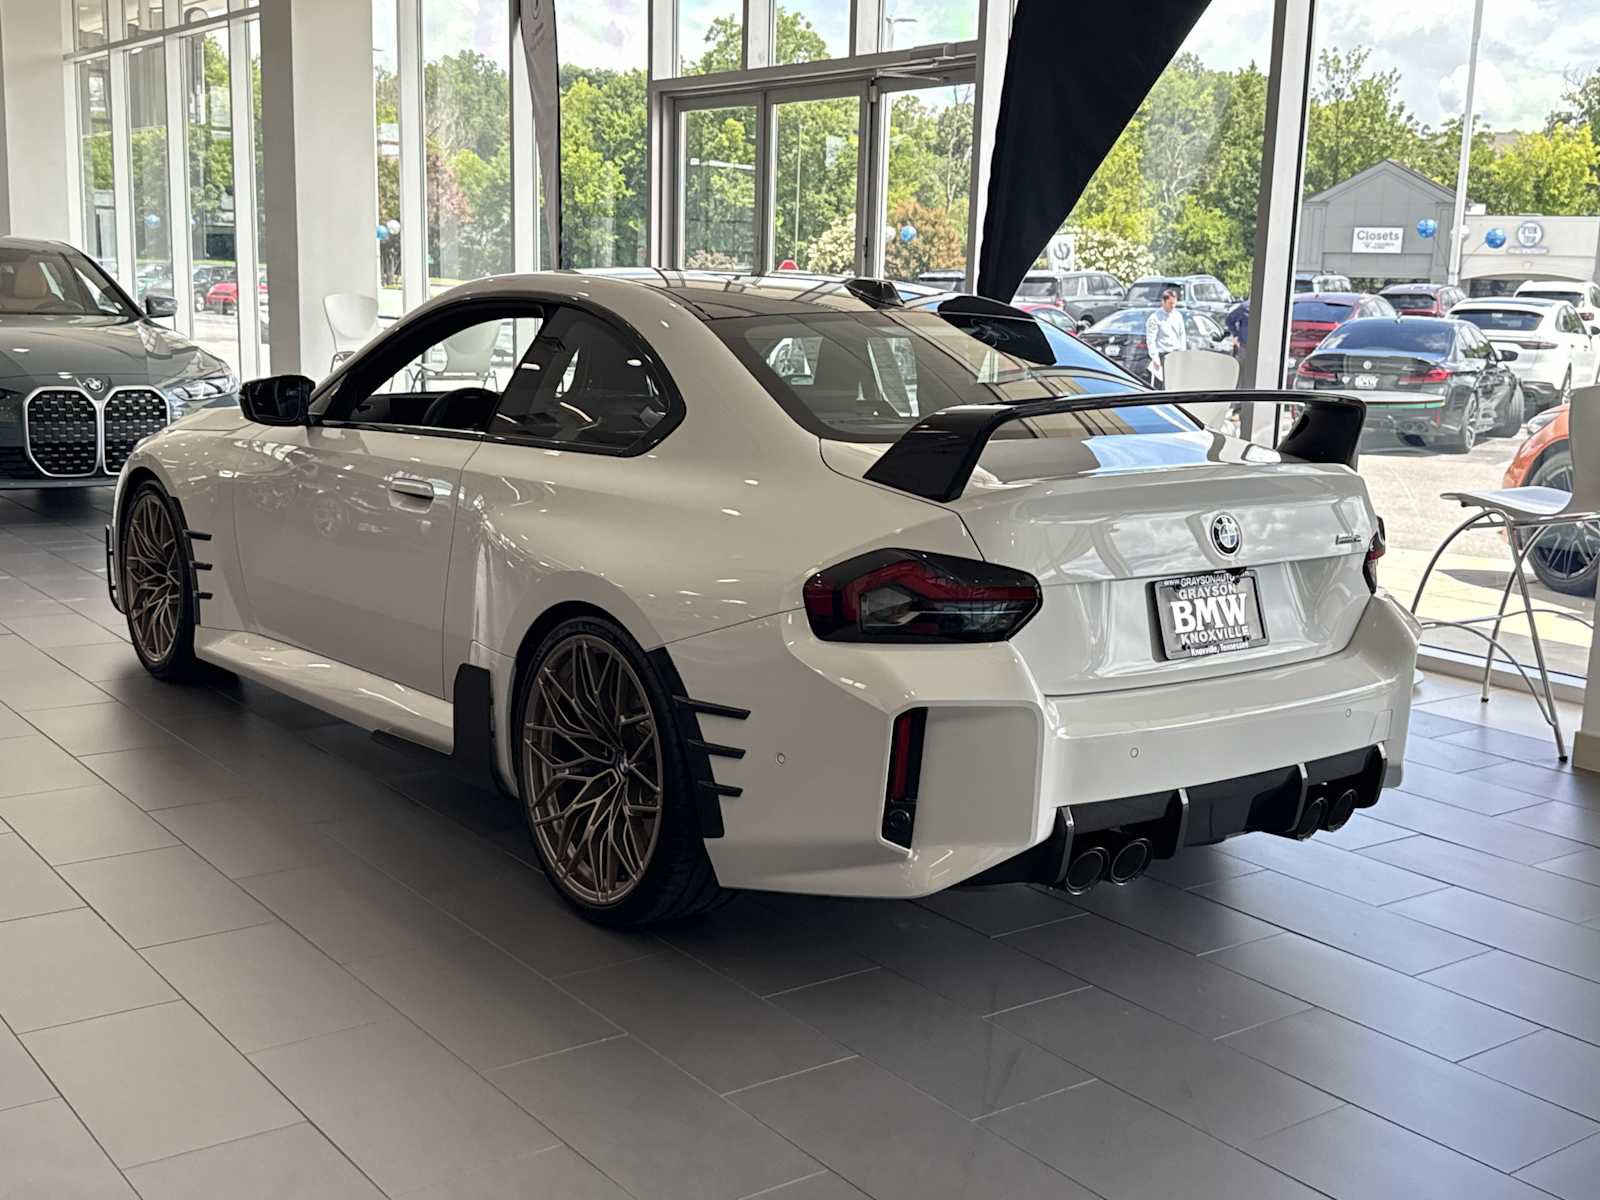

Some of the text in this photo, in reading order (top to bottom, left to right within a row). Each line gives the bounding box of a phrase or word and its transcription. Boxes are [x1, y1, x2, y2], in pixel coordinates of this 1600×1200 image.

[1356, 230, 1400, 241] Closets
[1178, 583, 1237, 601] GRAYSON
[1170, 592, 1247, 635] BMW
[1180, 625, 1250, 645] KNOXVILLE
